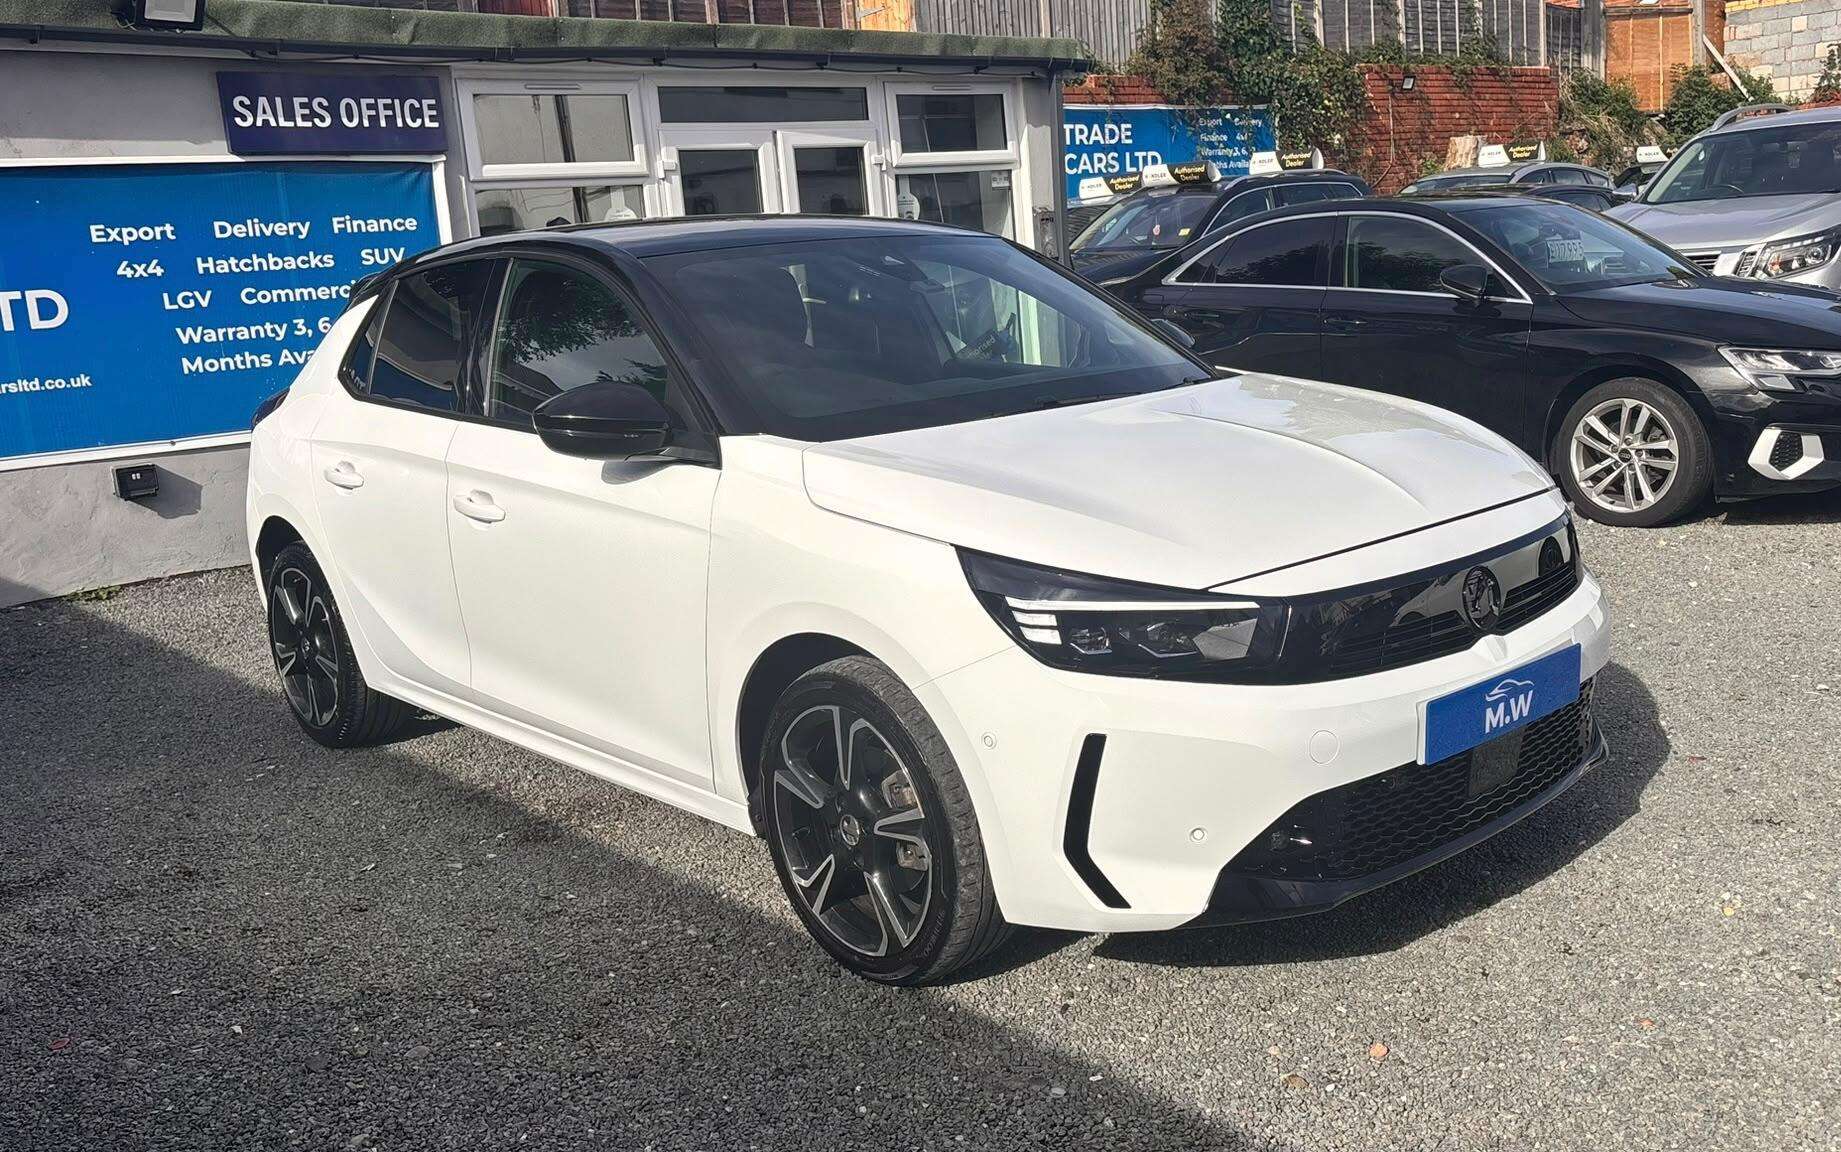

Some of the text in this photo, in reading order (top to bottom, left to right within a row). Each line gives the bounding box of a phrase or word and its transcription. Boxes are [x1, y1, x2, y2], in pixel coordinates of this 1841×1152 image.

[232, 95, 440, 128] SALES OFFICE
[1063, 123, 1133, 145] TRADE
[1064, 150, 1162, 175] CARS LTD
[1285, 159, 1304, 167] Dealer
[1114, 182, 1133, 191] Dealer
[89, 214, 418, 246] Export Delivery Finance
[116, 246, 405, 278] 4x4 Hatchbacks SUV
[162, 281, 355, 310] LGV Commerc
[175, 321, 288, 345] Warranty
[293, 318, 313, 338] 3,
[181, 350, 273, 375] Months
[0, 373, 92, 395] rsltd.co.uk
[1485, 690, 1534, 734] M.W
